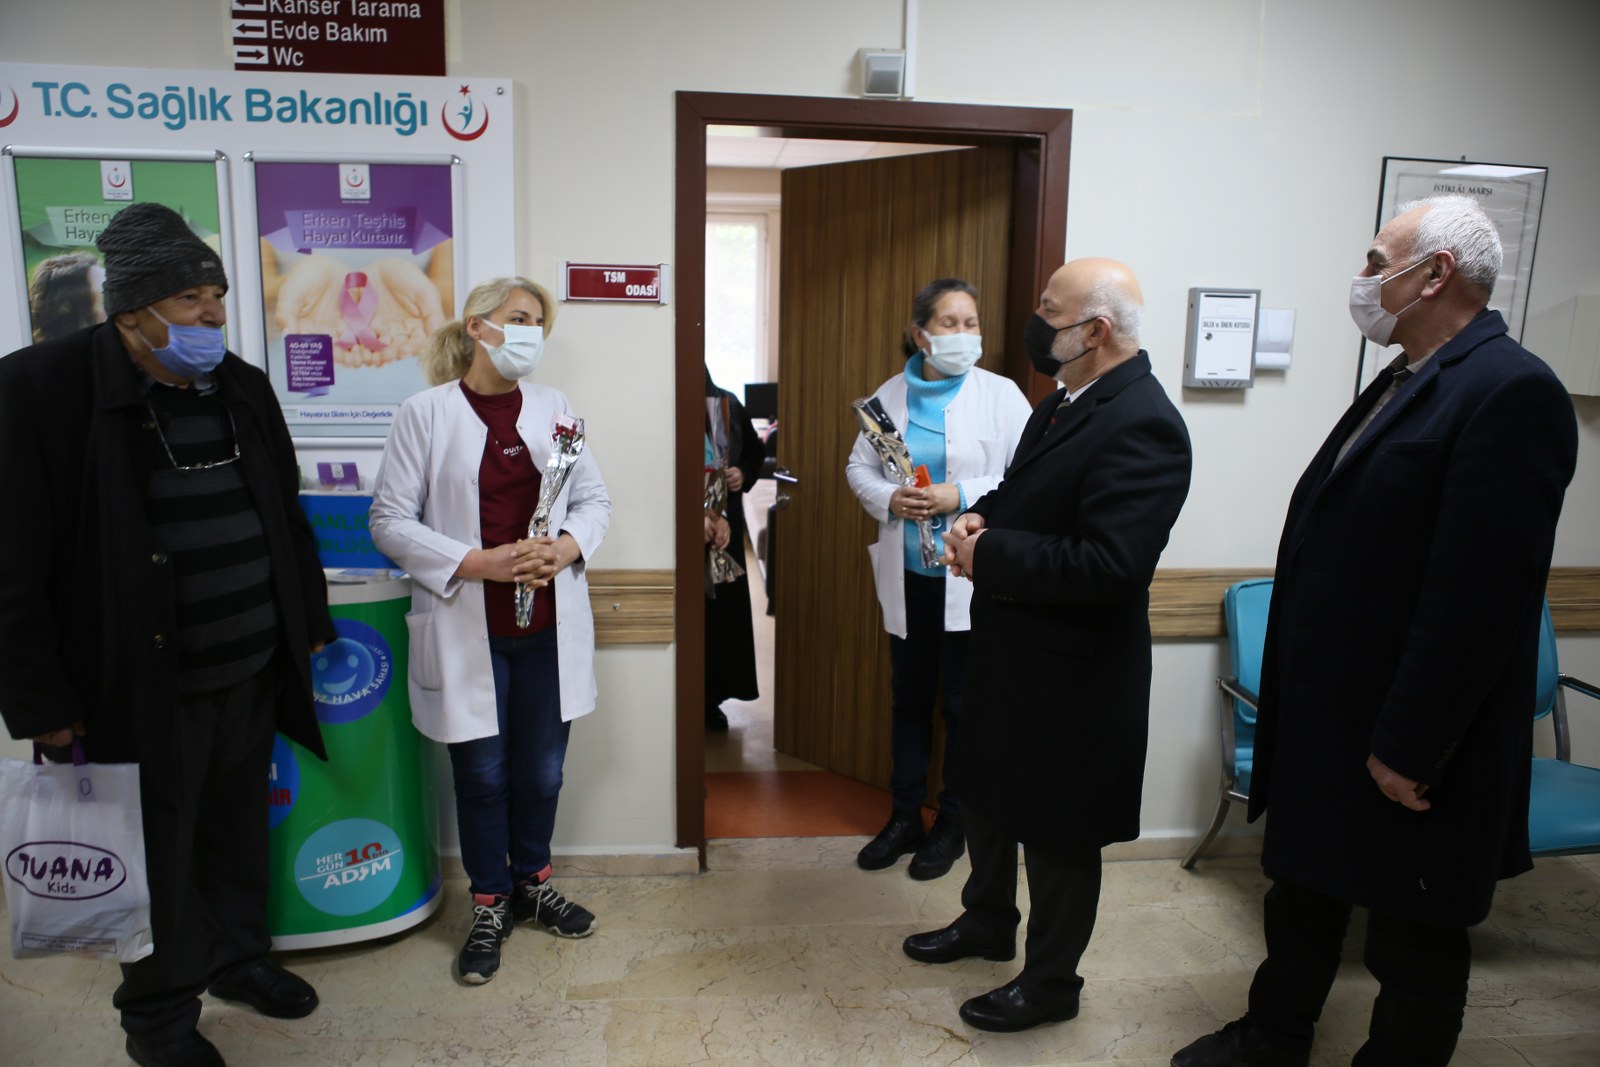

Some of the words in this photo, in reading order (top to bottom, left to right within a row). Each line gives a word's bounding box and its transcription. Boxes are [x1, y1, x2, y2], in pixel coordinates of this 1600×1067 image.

[269, 0, 340, 15] Kanser
[271, 20, 320, 40] Evde
[325, 22, 388, 43] Bakım
[273, 47, 304, 66] Wc
[31, 81, 98, 119] T.C.
[106, 82, 233, 131] Sağlık
[245, 87, 428, 137] Bakanlığı
[64, 208, 111, 225] Erken
[302, 212, 350, 229] Erken
[353, 212, 407, 232] Teşhis
[65, 226, 101, 243] Haya
[302, 230, 347, 246] Hayat
[603, 271, 626, 283] TSM
[316, 852, 343, 866] HER
[345, 841, 383, 866] 10
[18, 852, 115, 883] TUANA
[47, 881, 77, 895] Kids
